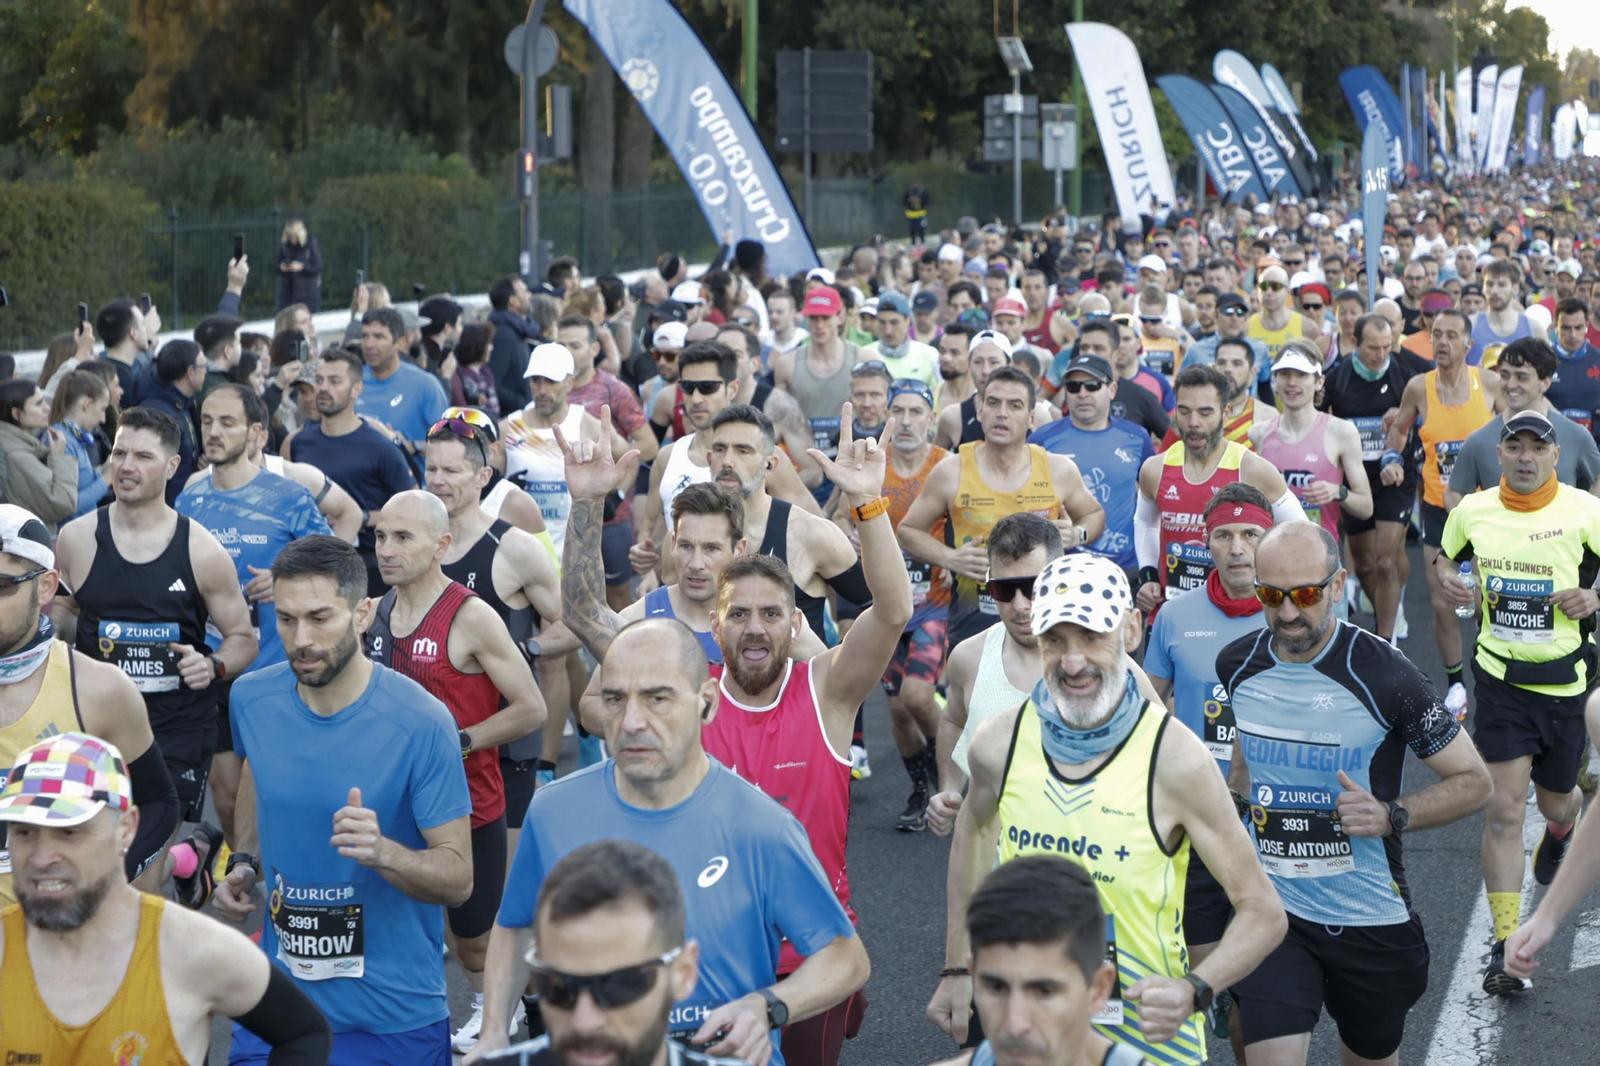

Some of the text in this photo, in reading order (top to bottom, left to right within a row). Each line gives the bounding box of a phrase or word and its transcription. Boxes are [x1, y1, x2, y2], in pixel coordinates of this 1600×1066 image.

[1513, 561, 1554, 577] RUNNERS
[1506, 582, 1545, 592] ZURICH
[1507, 600, 1528, 611] 3852
[1495, 610, 1545, 628] MOYCHE
[126, 627, 170, 638] ZURICH
[1195, 630, 1218, 638] SPORT
[126, 647, 151, 658] 3165
[1295, 744, 1363, 773] LEGUA
[1279, 790, 1331, 805] ZURICH
[1282, 818, 1309, 831] 3931
[1008, 825, 1103, 861] aprende
[1258, 838, 1350, 857] JOSE ANTONIO
[286, 886, 349, 901] ZURICH
[287, 914, 319, 930] 3991
